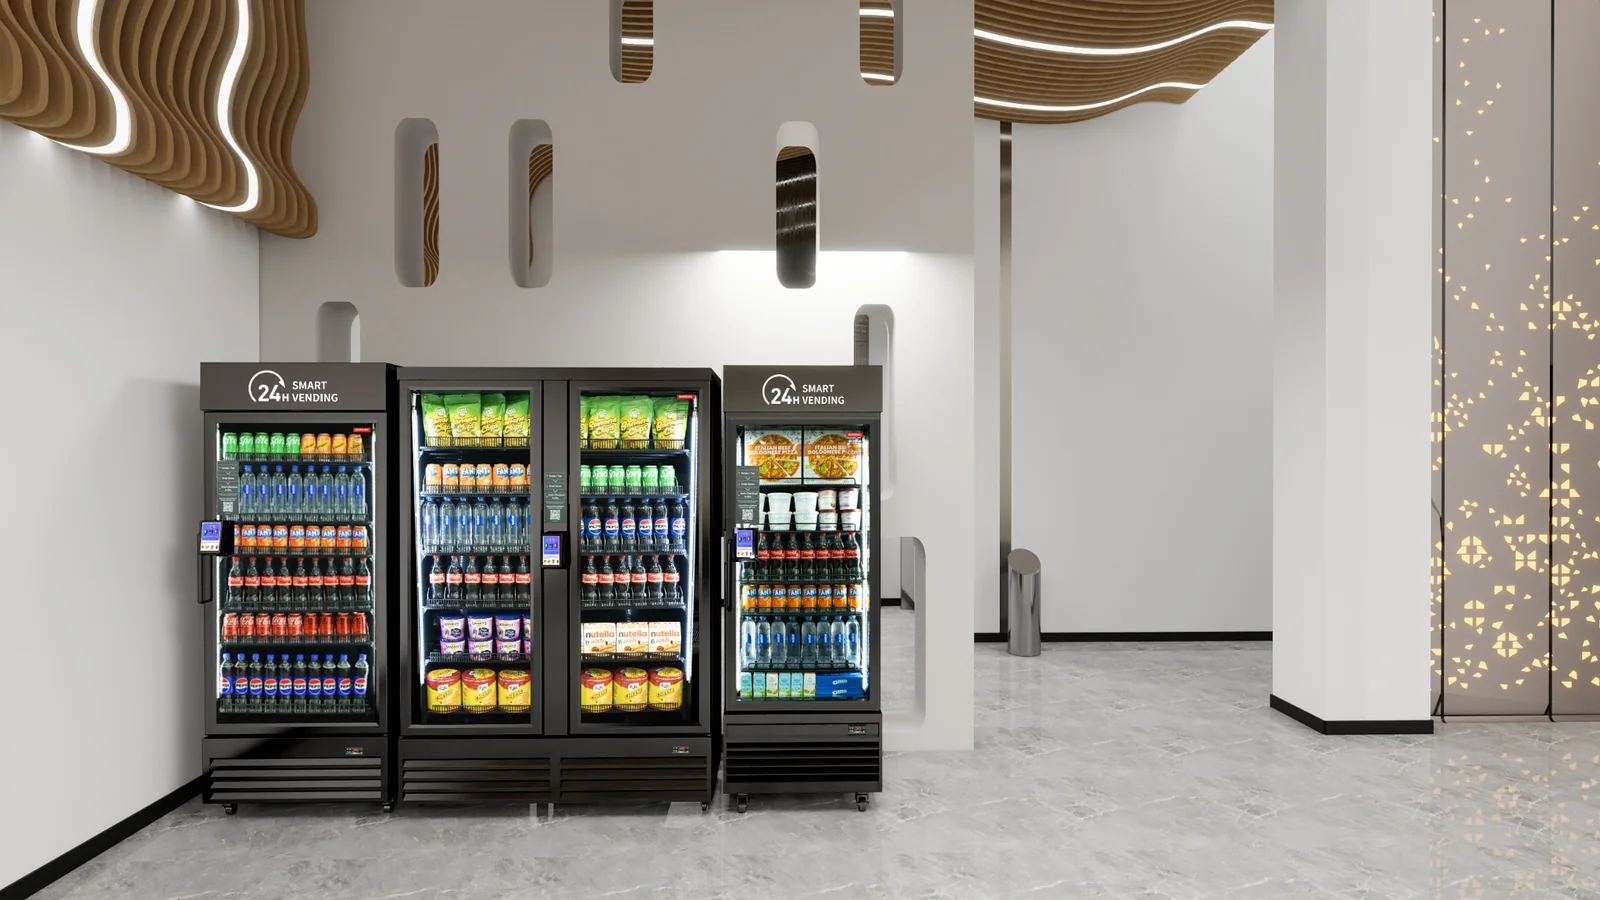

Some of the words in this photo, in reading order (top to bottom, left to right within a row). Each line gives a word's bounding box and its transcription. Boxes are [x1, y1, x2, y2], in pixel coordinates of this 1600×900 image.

[292, 381, 327, 390] SMART
[802, 384, 834, 393] SMART
[292, 393, 338, 402] VENDING
[802, 396, 845, 405] VENDING
[585, 630, 615, 638] nutella
[618, 629, 648, 637] nutella
[650, 629, 680, 637] nutella
